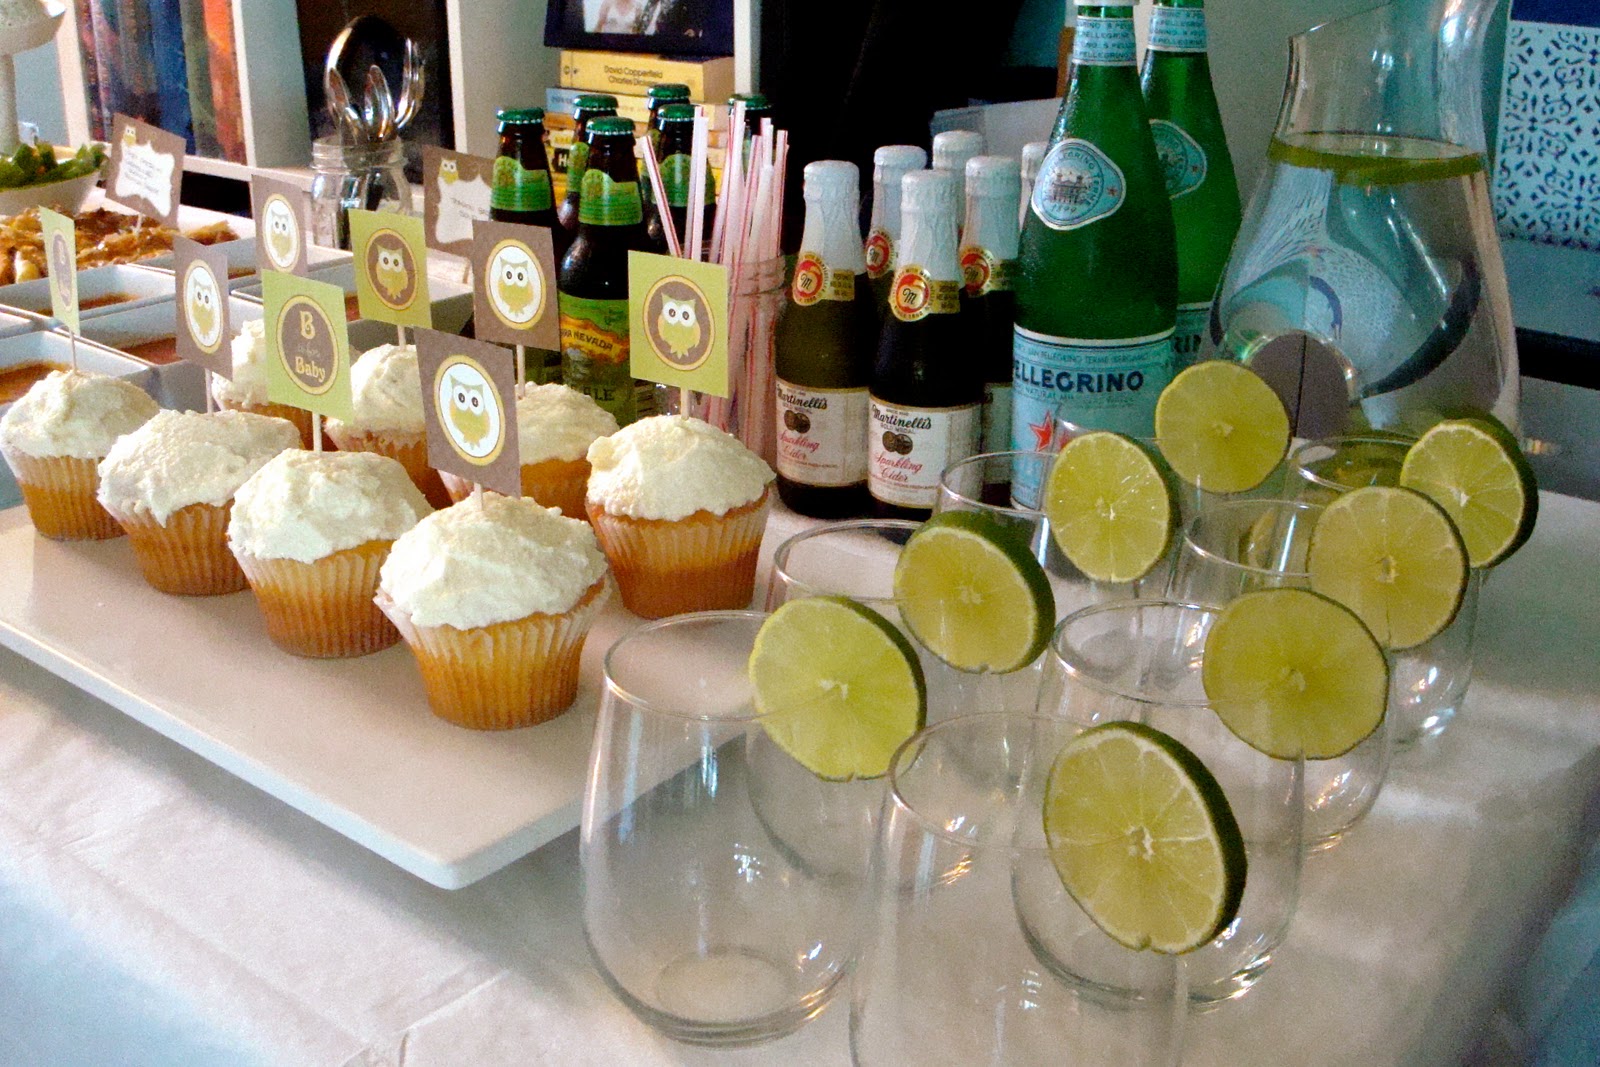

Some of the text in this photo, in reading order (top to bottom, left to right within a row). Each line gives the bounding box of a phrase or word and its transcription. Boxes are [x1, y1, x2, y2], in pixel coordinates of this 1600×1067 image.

[604, 65, 663, 79] David Copperfield
[300, 310, 315, 340] B
[573, 330, 613, 351] NEVADA
[295, 356, 325, 382] Baby
[872, 404, 932, 430] Martinelli's
[875, 451, 924, 474] Sparkling
[881, 467, 908, 482] Cider
